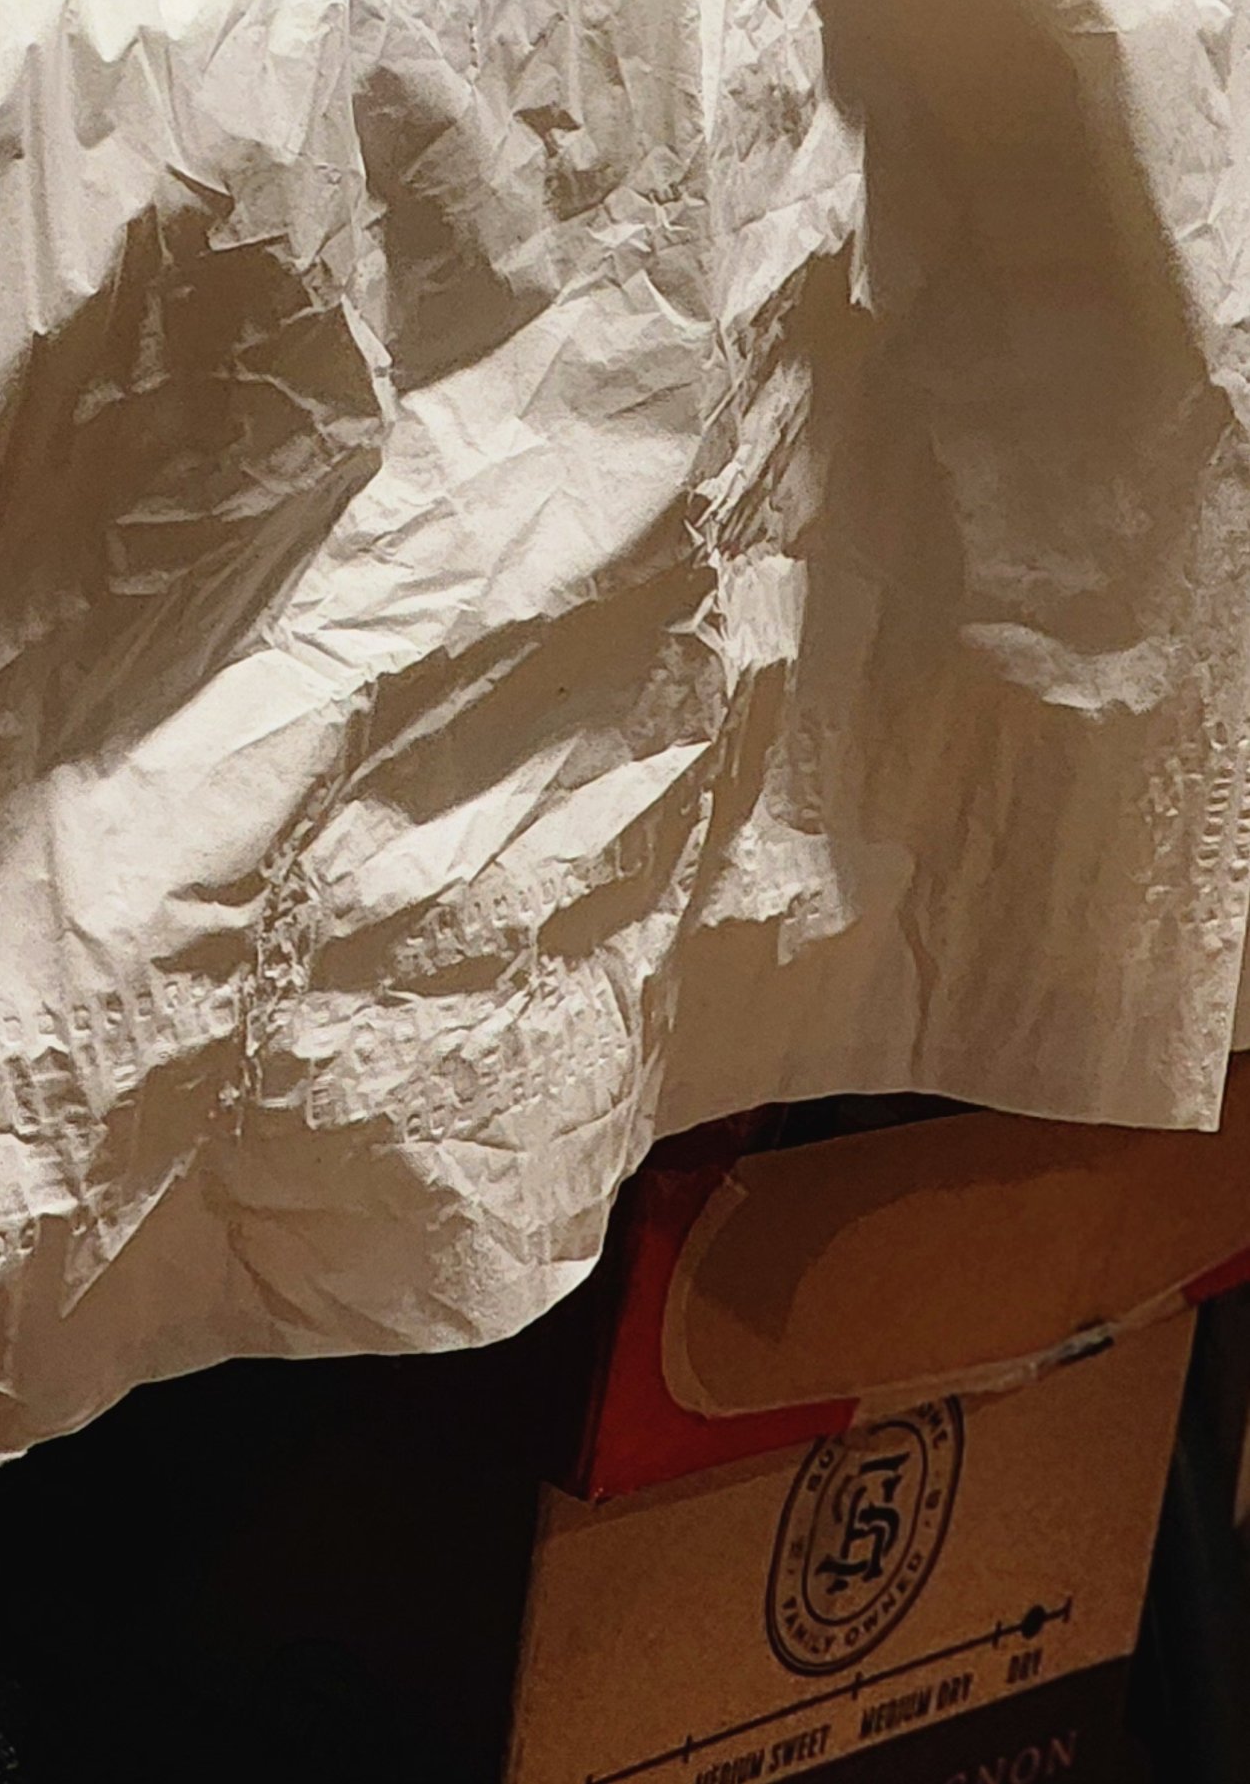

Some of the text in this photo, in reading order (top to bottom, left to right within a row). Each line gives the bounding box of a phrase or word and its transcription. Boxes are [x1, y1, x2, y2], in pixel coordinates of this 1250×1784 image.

[844, 1553, 922, 1647] OWNED
[1006, 1647, 1043, 1684] DRY
[859, 1672, 973, 1739] MEDIUM DRY
[769, 1724, 831, 1772] SWEET
